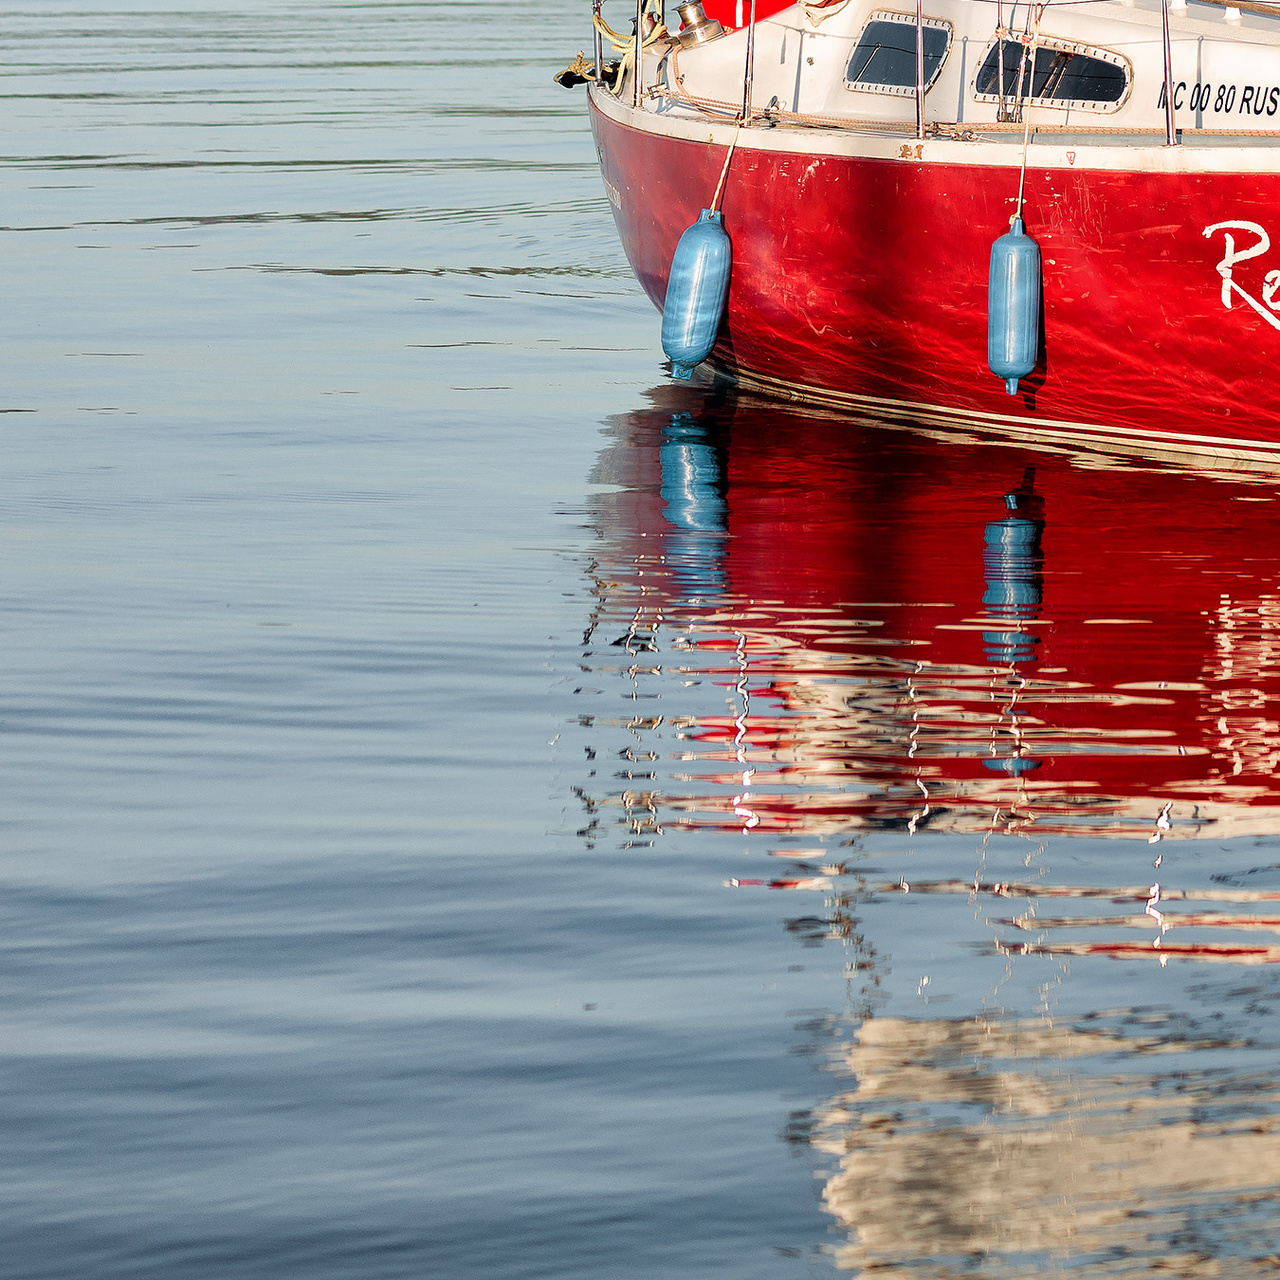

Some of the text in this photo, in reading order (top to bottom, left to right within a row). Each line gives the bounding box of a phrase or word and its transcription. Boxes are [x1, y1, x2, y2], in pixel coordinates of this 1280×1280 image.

[1190, 83, 1211, 112] 00
[1214, 85, 1236, 113] 80
[1239, 86, 1280, 116] RUS
